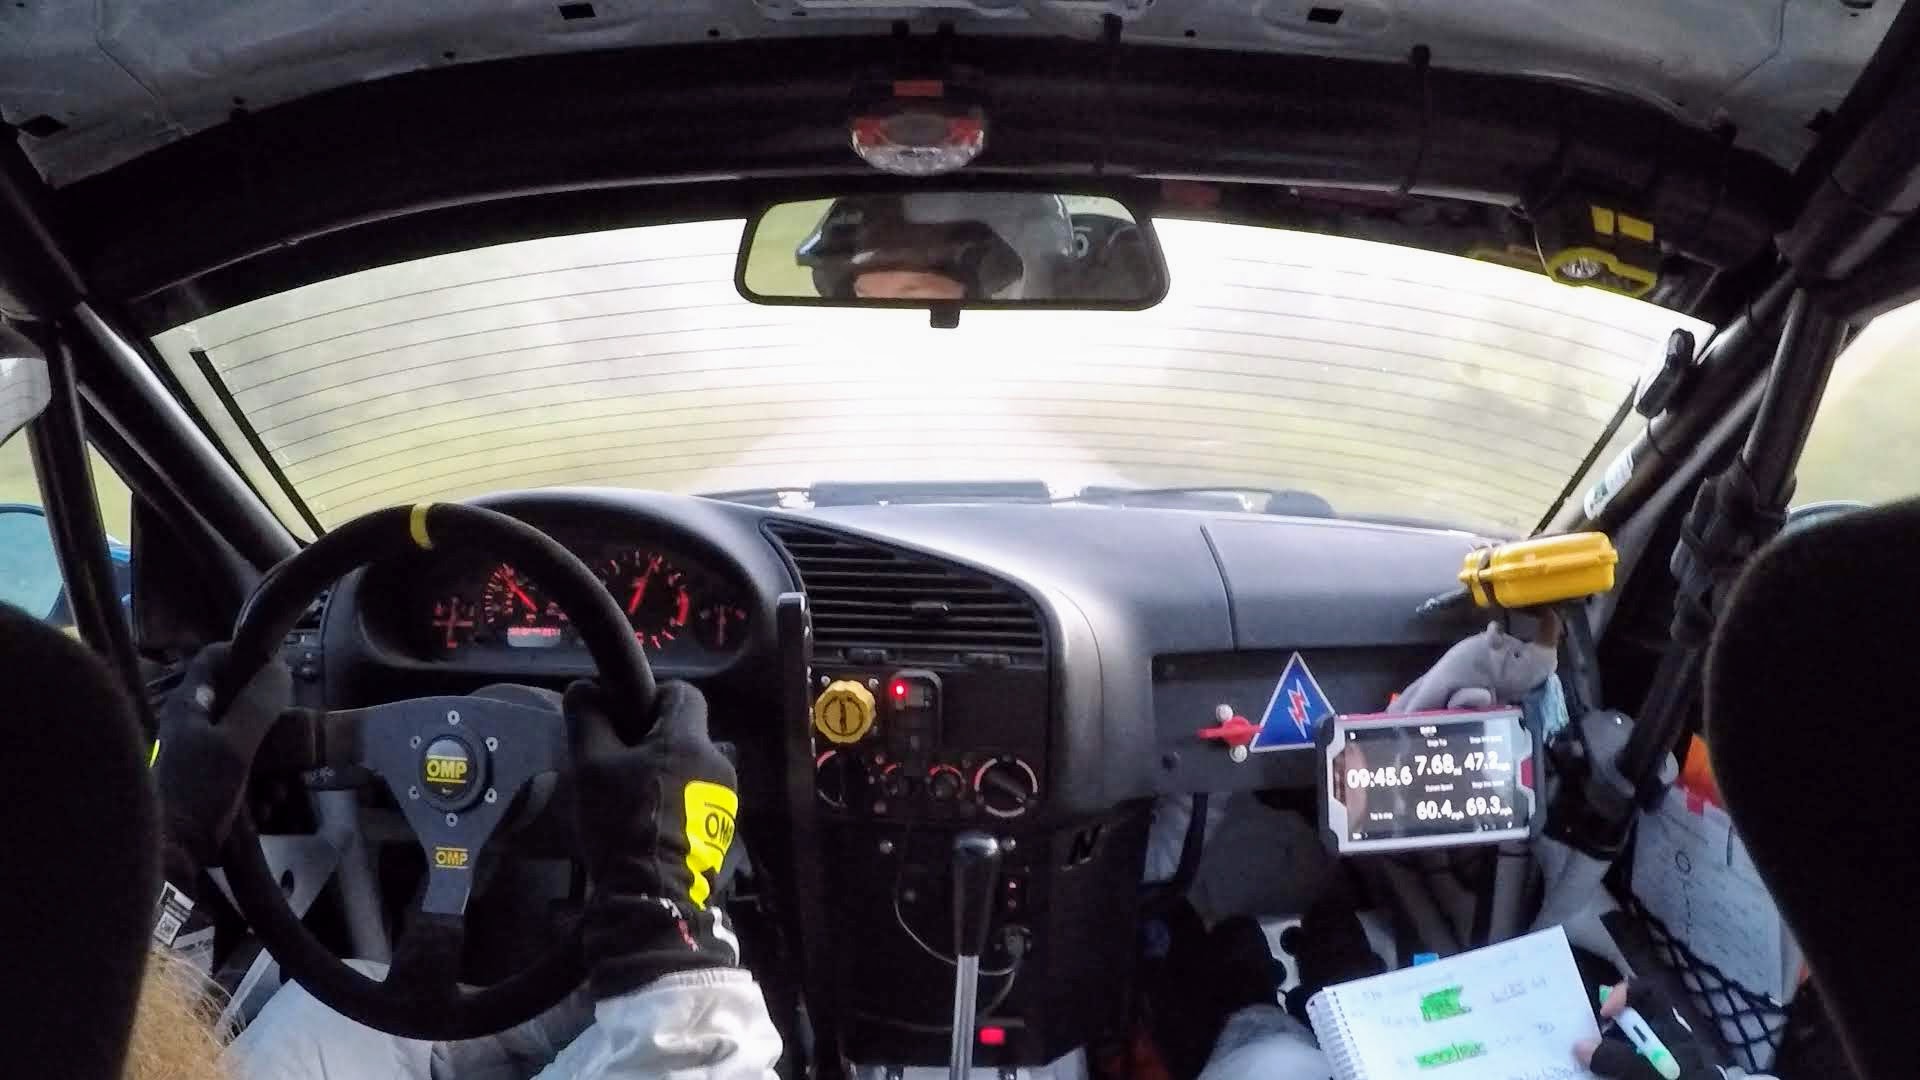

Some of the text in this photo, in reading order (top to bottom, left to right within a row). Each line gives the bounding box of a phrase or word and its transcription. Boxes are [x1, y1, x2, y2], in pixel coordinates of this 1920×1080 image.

[426, 760, 467, 779] OMP
[1415, 754, 1455, 776] 7.68
[1416, 799, 1452, 820] 60.4
[1466, 796, 1501, 817] 69.3
[705, 812, 734, 847] OM
[435, 851, 468, 866] OMP
